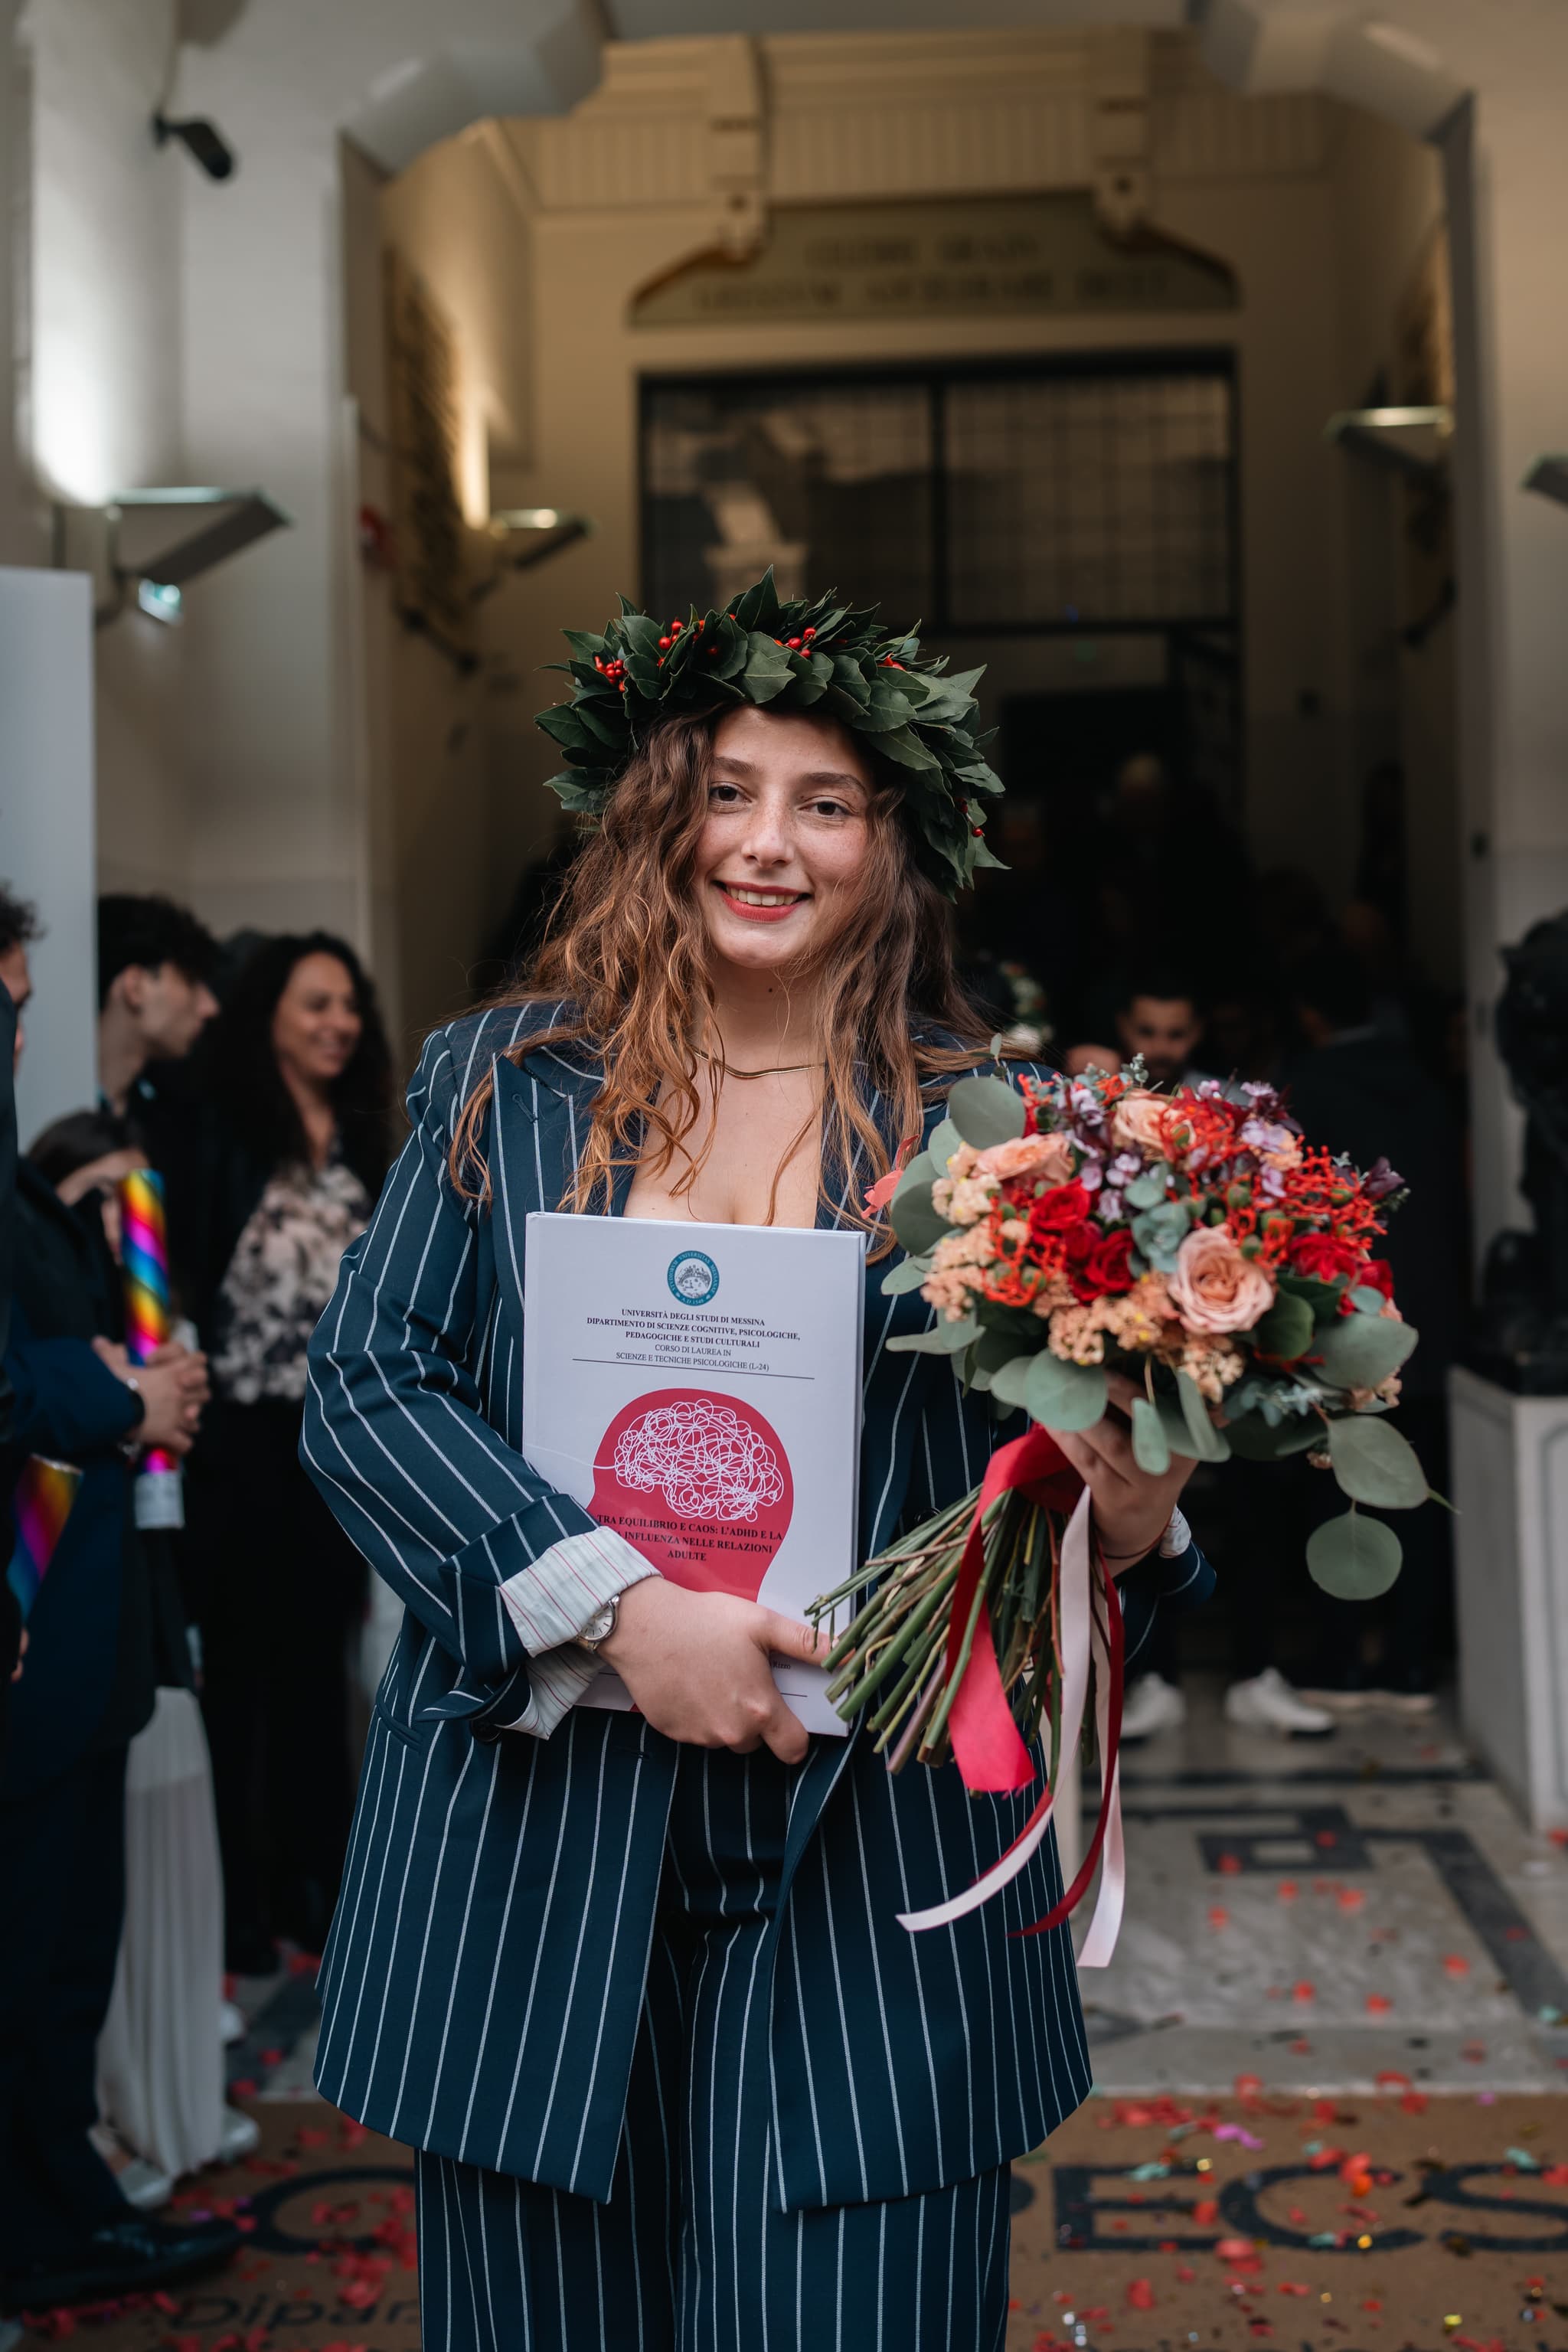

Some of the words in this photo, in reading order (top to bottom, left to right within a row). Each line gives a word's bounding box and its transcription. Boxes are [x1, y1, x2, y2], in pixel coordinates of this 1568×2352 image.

[622, 1308, 668, 1319] UNIVERSITÀ
[670, 1312, 694, 1321] DEGLI
[695, 1315, 718, 1323] STUDI
[730, 1317, 765, 1326] MESSINA
[586, 1318, 645, 1328] DIPARTIMENTO
[657, 1322, 690, 1331] SCIENZE
[691, 1325, 737, 1336] COGNITIVE,
[739, 1328, 801, 1341] PSICOLOGICHE,
[626, 1331, 682, 1342] PEDAGOGICHE
[691, 1336, 714, 1344] STUDI
[715, 1338, 760, 1348] CULTURALI
[655, 1344, 680, 1352] CORSO
[691, 1347, 722, 1356] LAUREA
[616, 1352, 646, 1361] SCIENZE
[655, 1355, 691, 1364] TECNICHE
[693, 1358, 747, 1369] PSICOLOGICHE
[749, 1363, 769, 1371] (L-24)
[597, 1514, 616, 1524] TRA
[619, 1517, 678, 1530] EQUILIBRIO
[680, 1522, 686, 1530] E
[688, 1524, 718, 1534] CAOS:
[761, 1530, 766, 1539] E
[769, 1531, 782, 1540] LA
[624, 1531, 680, 1544] INFLUENZA
[682, 1537, 714, 1548] NELLE
[717, 1540, 773, 1553] RELAZIONI
[668, 1550, 707, 1561] ADULTE
